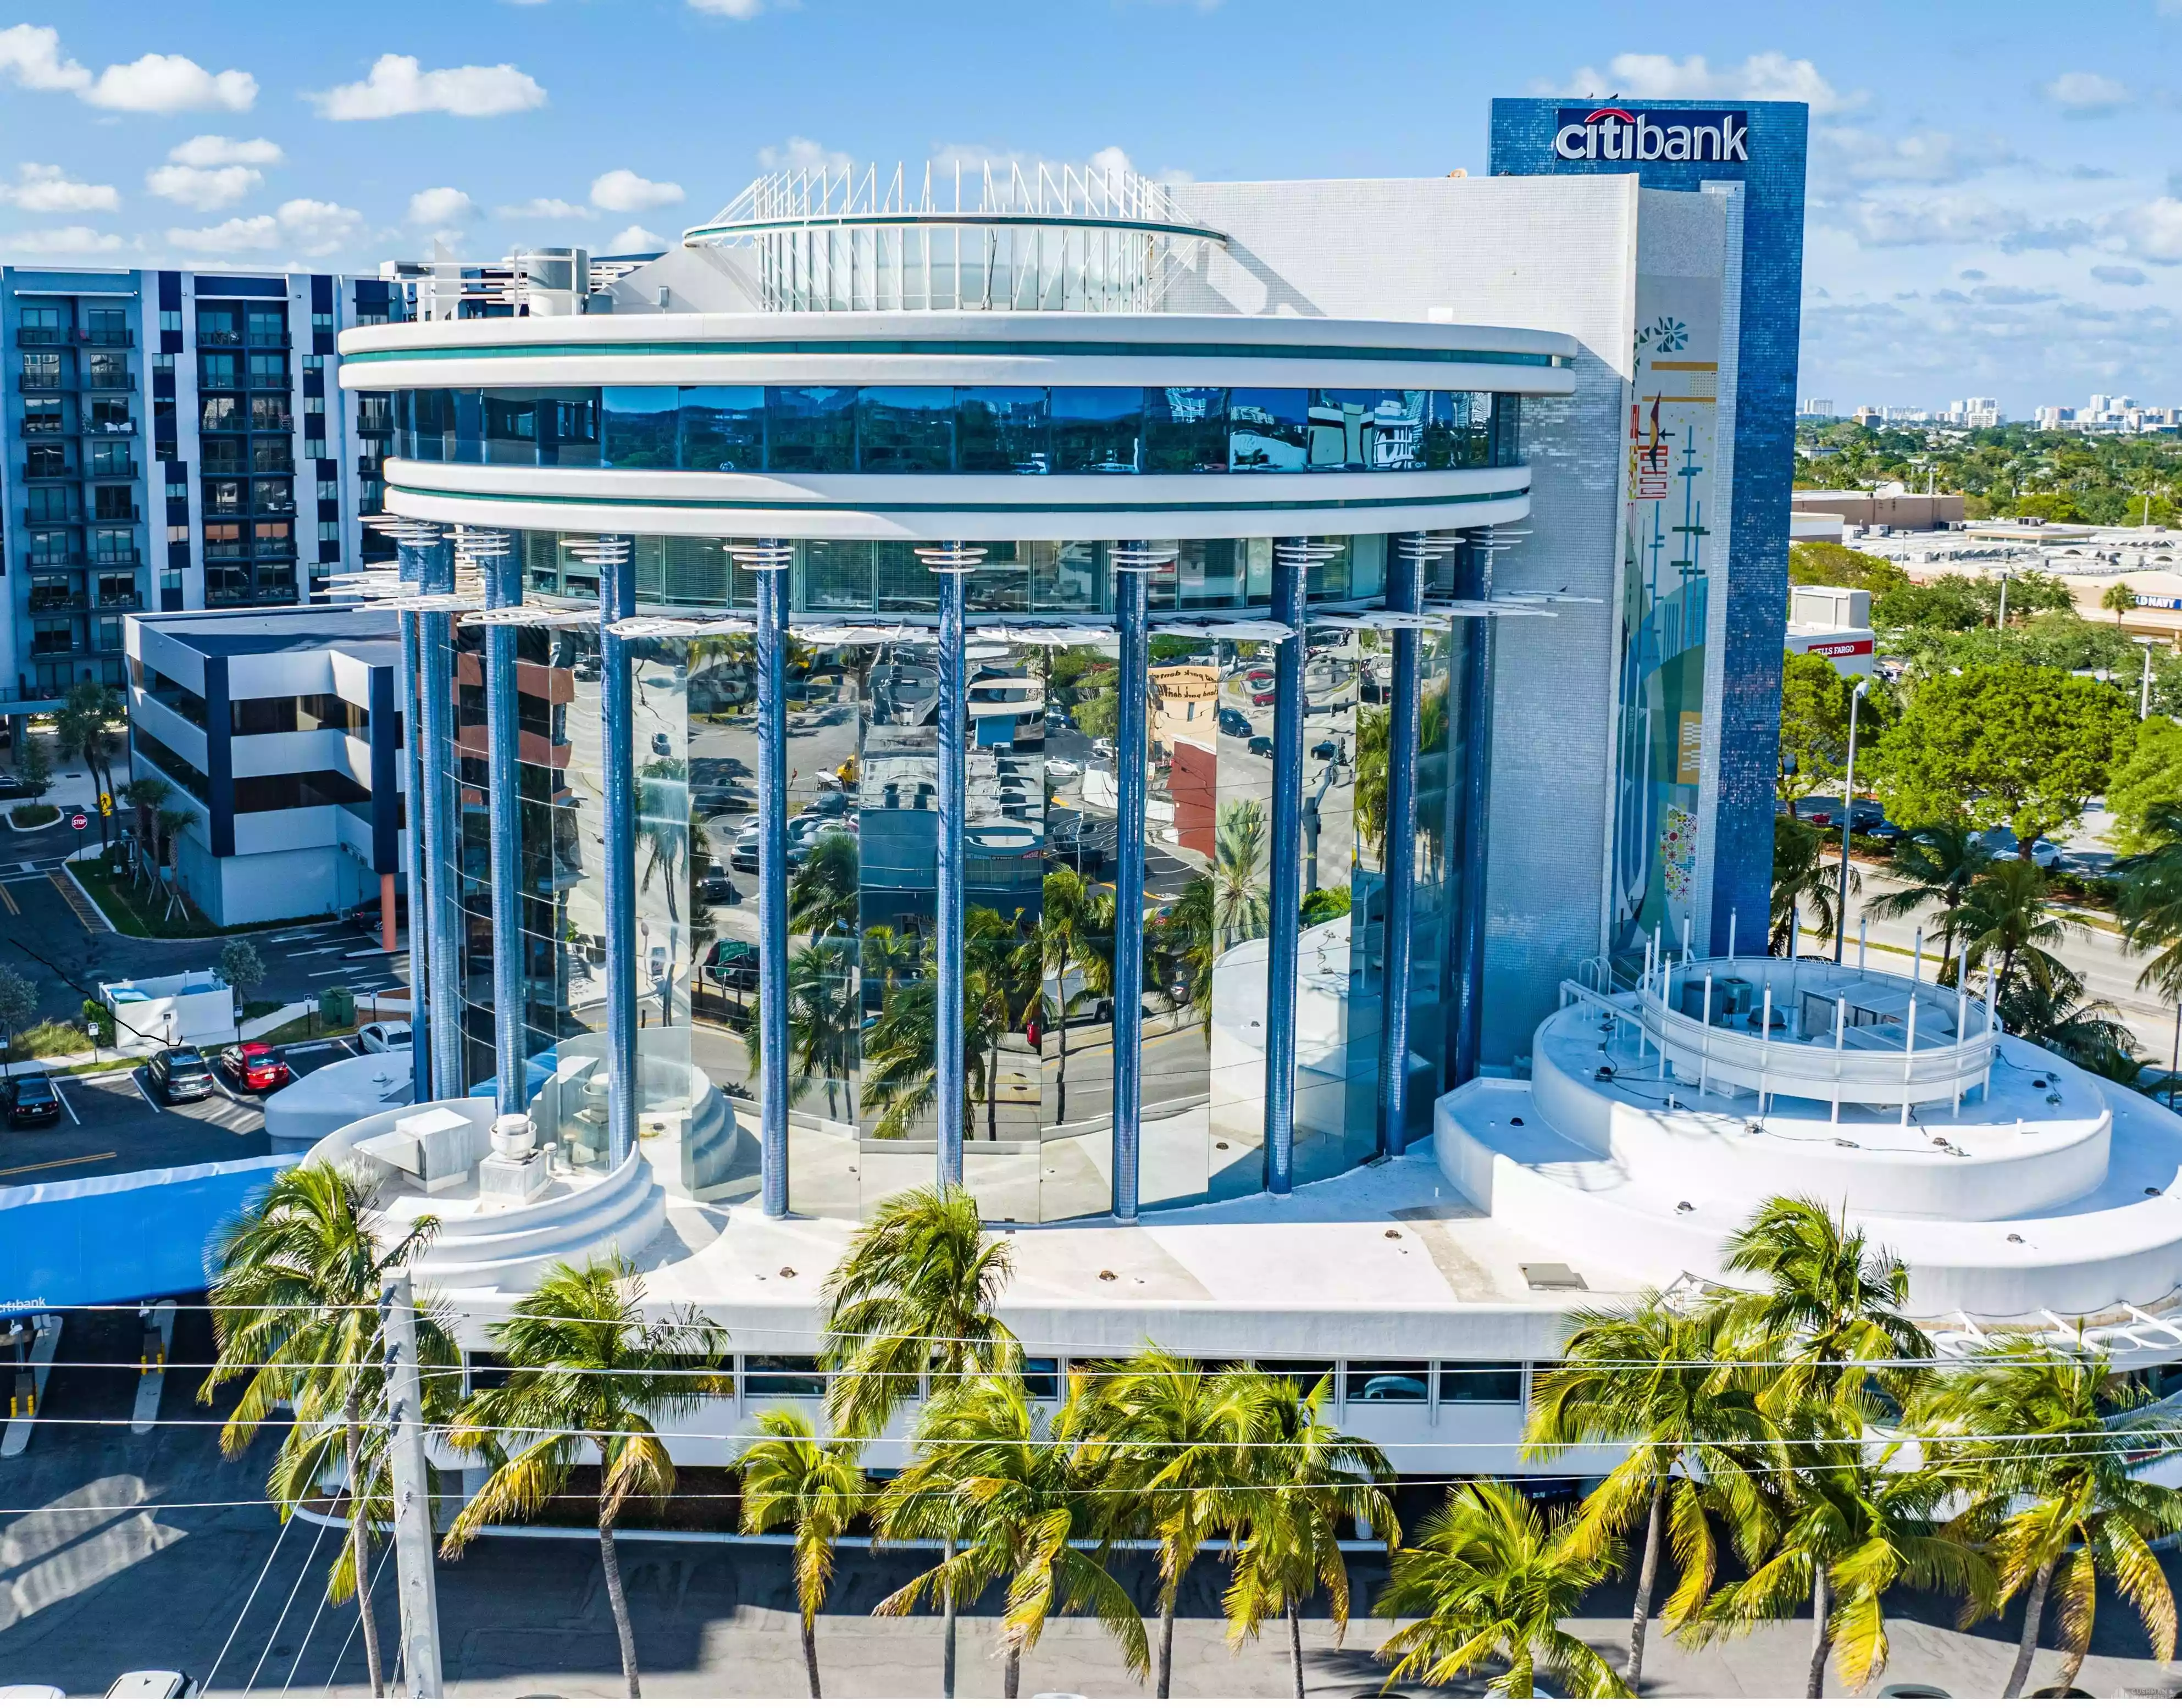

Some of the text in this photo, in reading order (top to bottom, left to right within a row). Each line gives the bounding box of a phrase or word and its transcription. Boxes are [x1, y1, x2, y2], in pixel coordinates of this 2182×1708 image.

[1556, 113, 1748, 160] citibank
[2148, 597, 2175, 608] NAVY
[1834, 645, 1854, 654] FARGO
